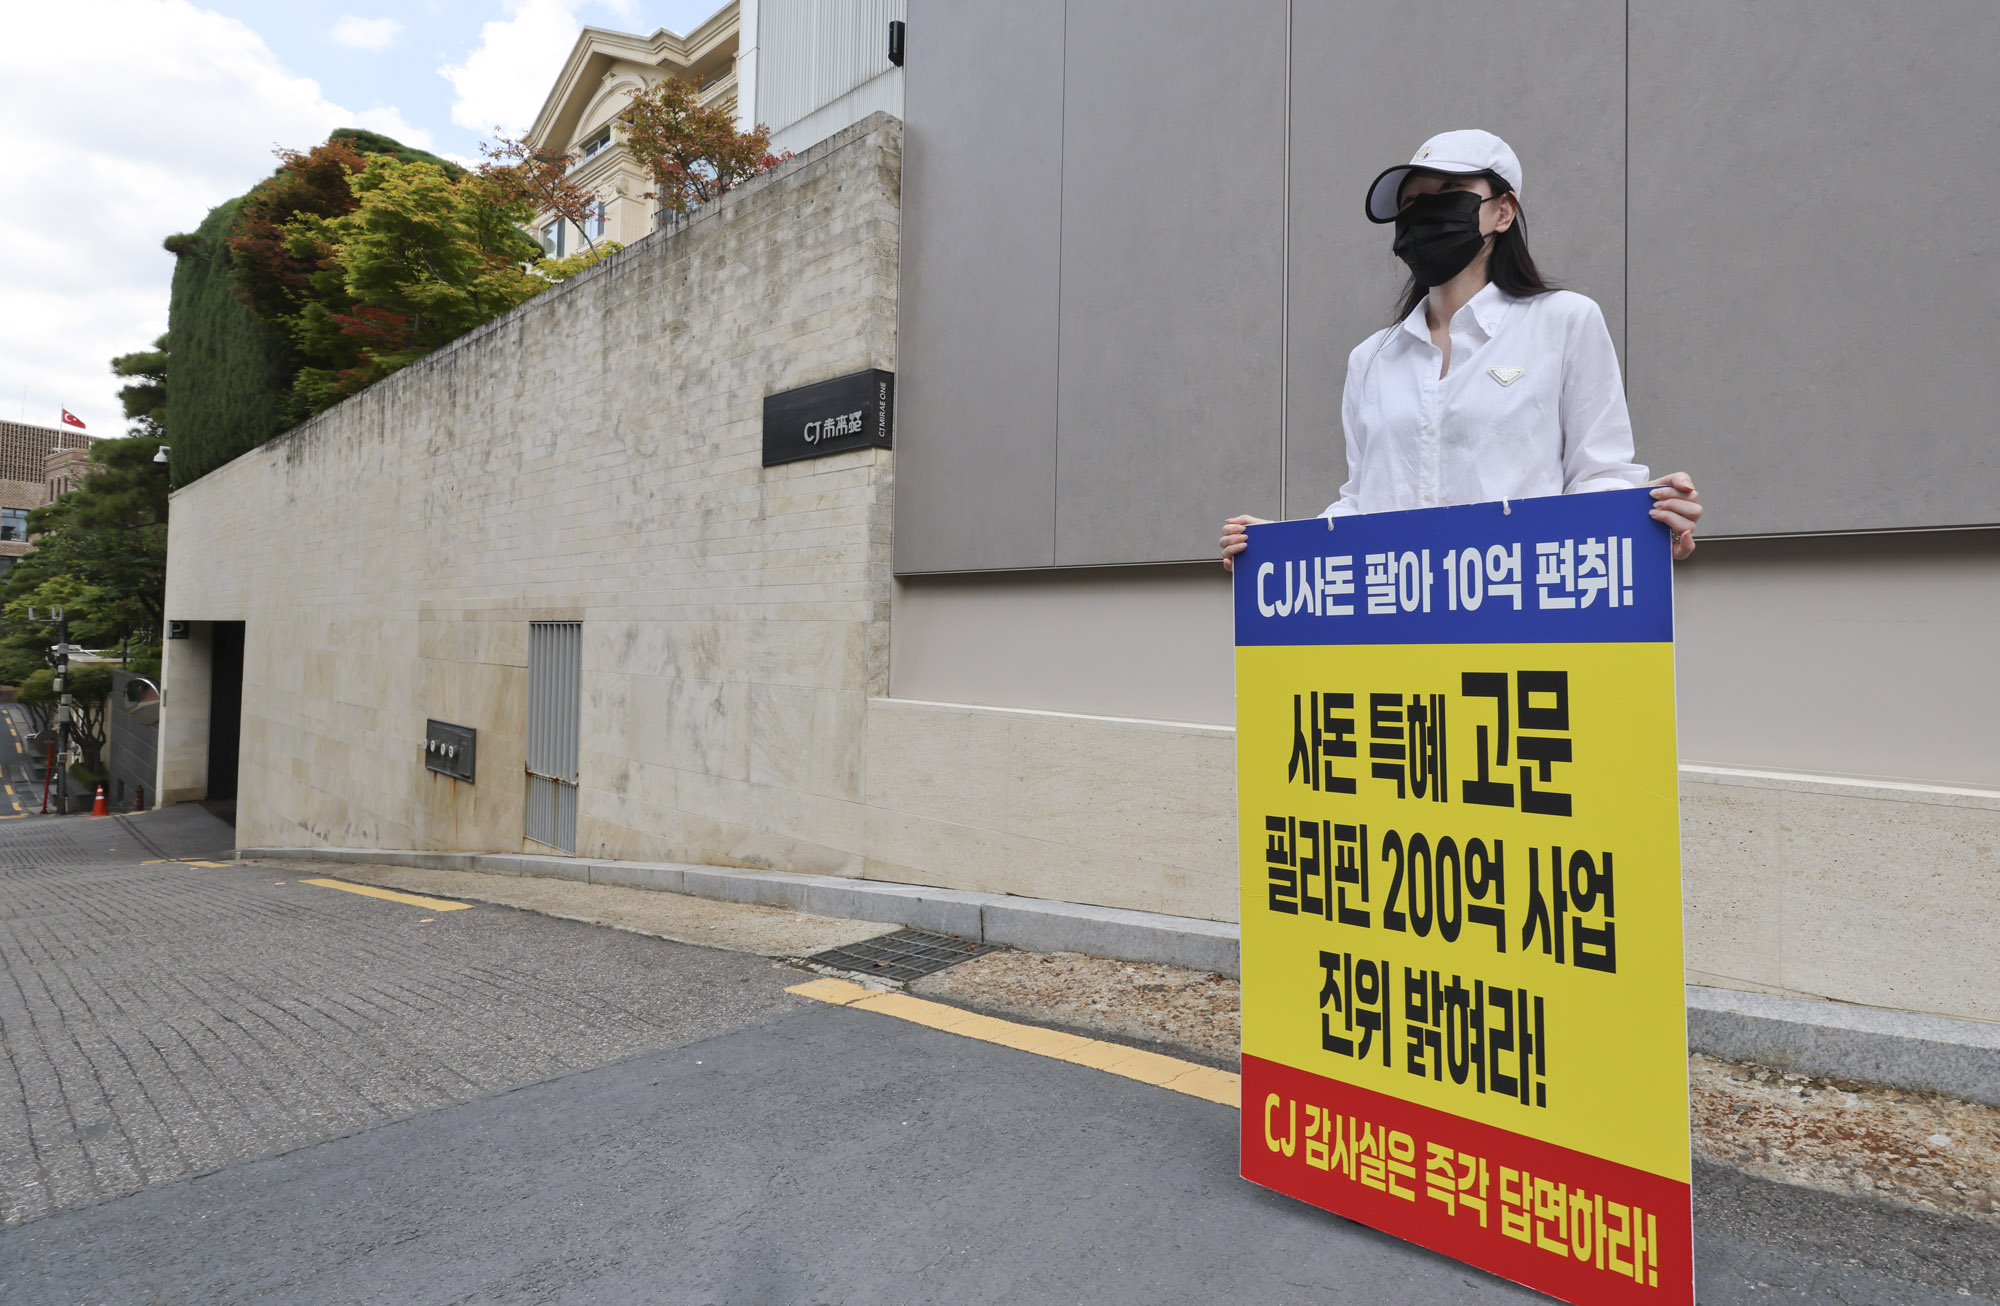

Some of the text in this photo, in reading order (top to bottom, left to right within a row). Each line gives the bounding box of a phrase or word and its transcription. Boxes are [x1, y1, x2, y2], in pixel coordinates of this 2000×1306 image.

[804, 421, 821, 445] CJ
[879, 427, 885, 437] CJ
[1257, 536, 1634, 617] CJ사돈 팔아 10억 편취!
[1288, 670, 1573, 818] 사돈 특혜 고문
[1265, 815, 1617, 974] 필리핀 200억 사업
[1319, 950, 1547, 1109] 진위 밝혀라!
[1265, 1093, 1658, 1288] CJ 감사실은 즉각 답면하라!
